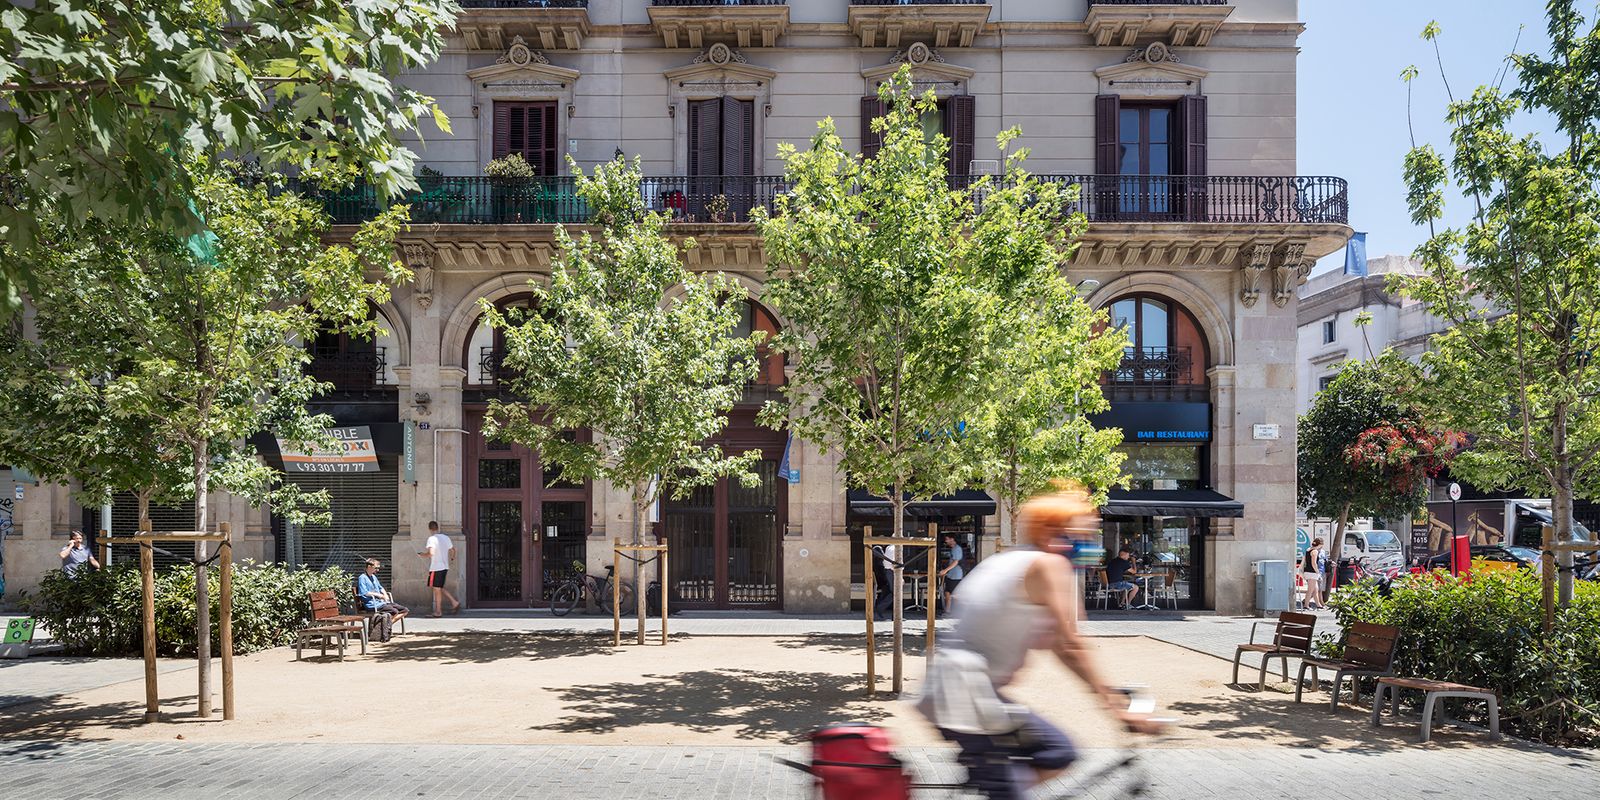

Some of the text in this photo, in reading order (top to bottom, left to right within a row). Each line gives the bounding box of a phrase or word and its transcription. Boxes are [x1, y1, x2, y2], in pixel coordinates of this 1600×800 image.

[1137, 431, 1209, 439] BAR RESTAURANT
[303, 462, 365, 472] 93 301 77 77
